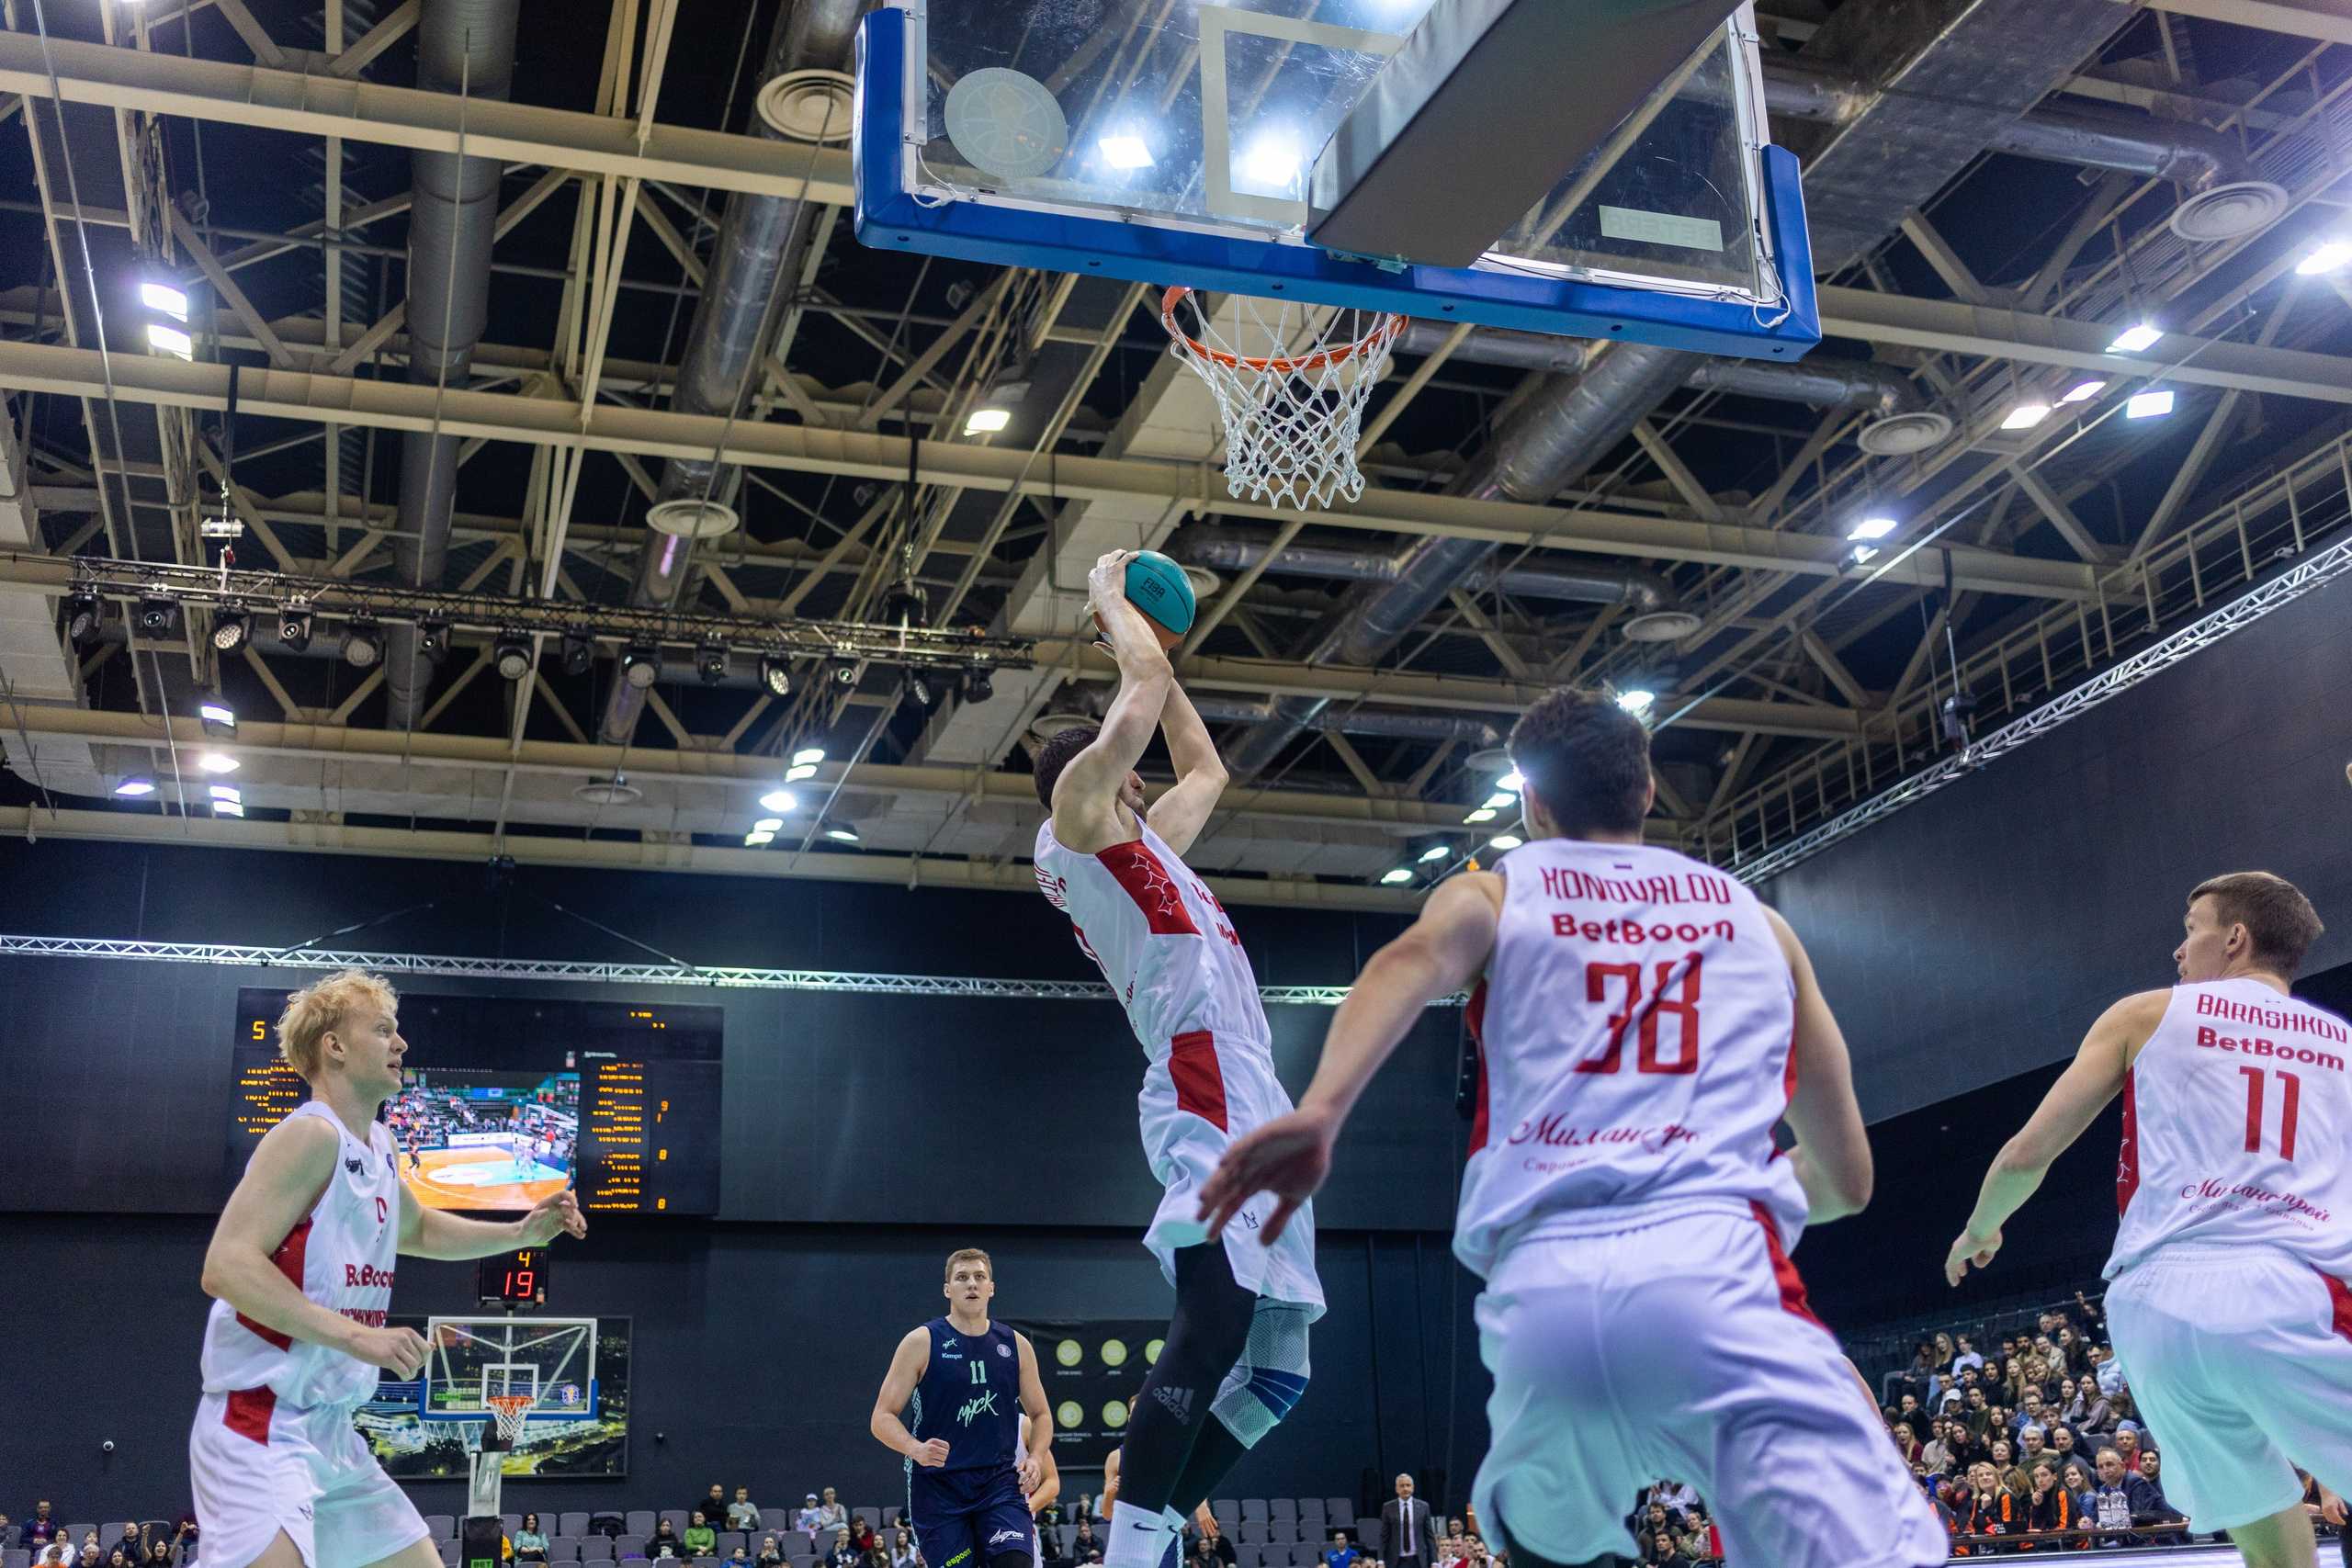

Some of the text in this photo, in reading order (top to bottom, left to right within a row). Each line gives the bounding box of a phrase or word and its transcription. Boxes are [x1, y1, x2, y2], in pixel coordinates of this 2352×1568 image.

[1143, 577, 1166, 599] FIBA
[1551, 914, 1735, 945] BetBoom
[1572, 950, 1703, 1075] 38
[2196, 993, 2348, 1044] BARASHKOV
[2197, 1026, 2345, 1072] BetBoom
[2239, 1066, 2301, 1163] 11
[518, 1251, 531, 1268] 4
[504, 1271, 534, 1297] 19
[942, 1352, 963, 1360] Kempa
[969, 1360, 988, 1384] 11
[1152, 1387, 1191, 1426] adidas
